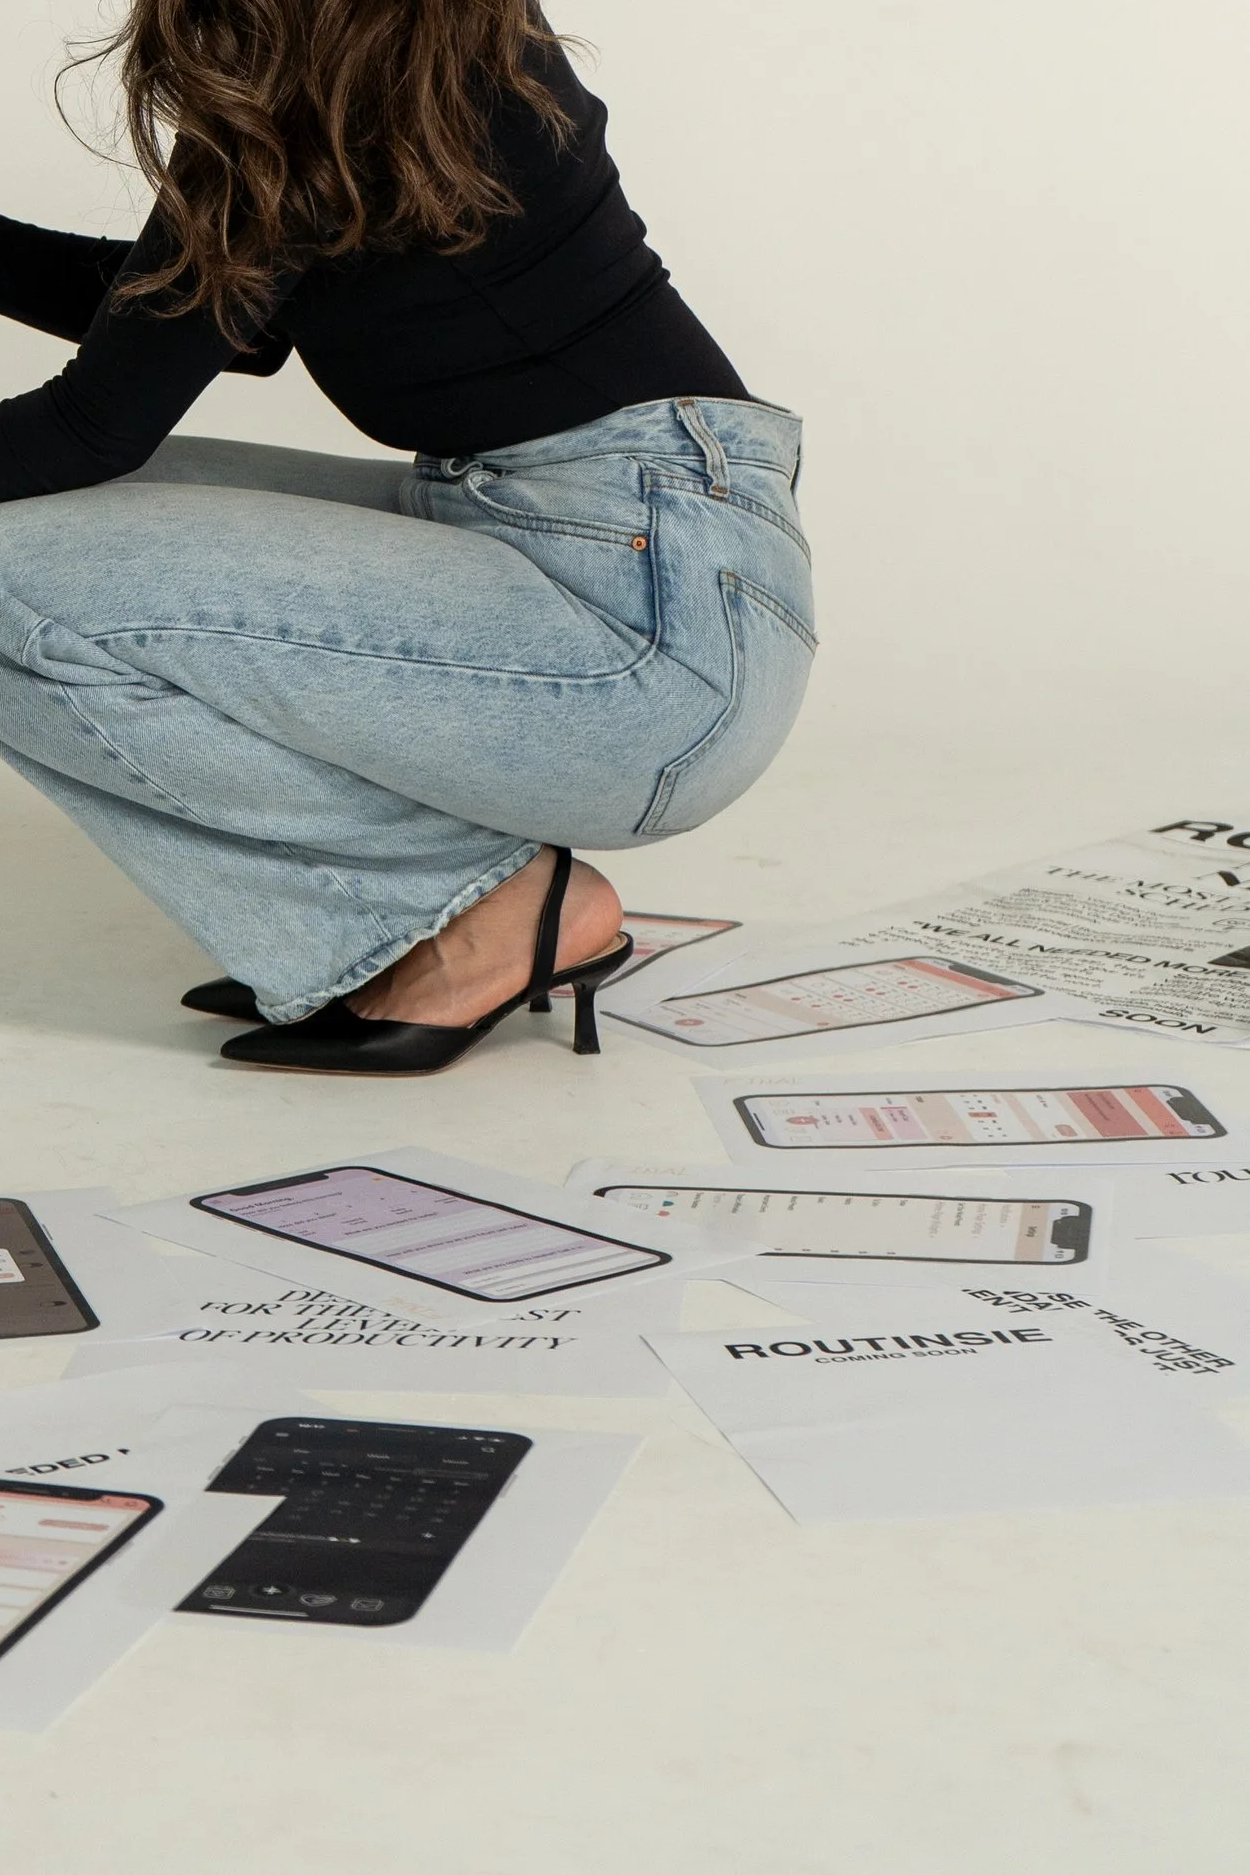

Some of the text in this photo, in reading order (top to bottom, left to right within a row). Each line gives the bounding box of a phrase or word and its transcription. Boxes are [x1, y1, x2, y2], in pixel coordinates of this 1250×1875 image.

[1047, 866, 1241, 903] THE MOST
[968, 933, 1020, 948] ALL
[1028, 944, 1152, 965] NEEDED
[1099, 1009, 1218, 1034] SOON
[200, 1302, 283, 1316] FOR
[294, 1303, 378, 1318] THE
[178, 1329, 578, 1350] OF PRODUCTIVITY
[723, 1328, 1054, 1360] ROUTINSIE
[1094, 1309, 1146, 1331] THE
[1140, 1331, 1237, 1369] OTHER
[814, 1346, 979, 1364] COMING SOON
[1139, 1347, 1221, 1375] JUST
